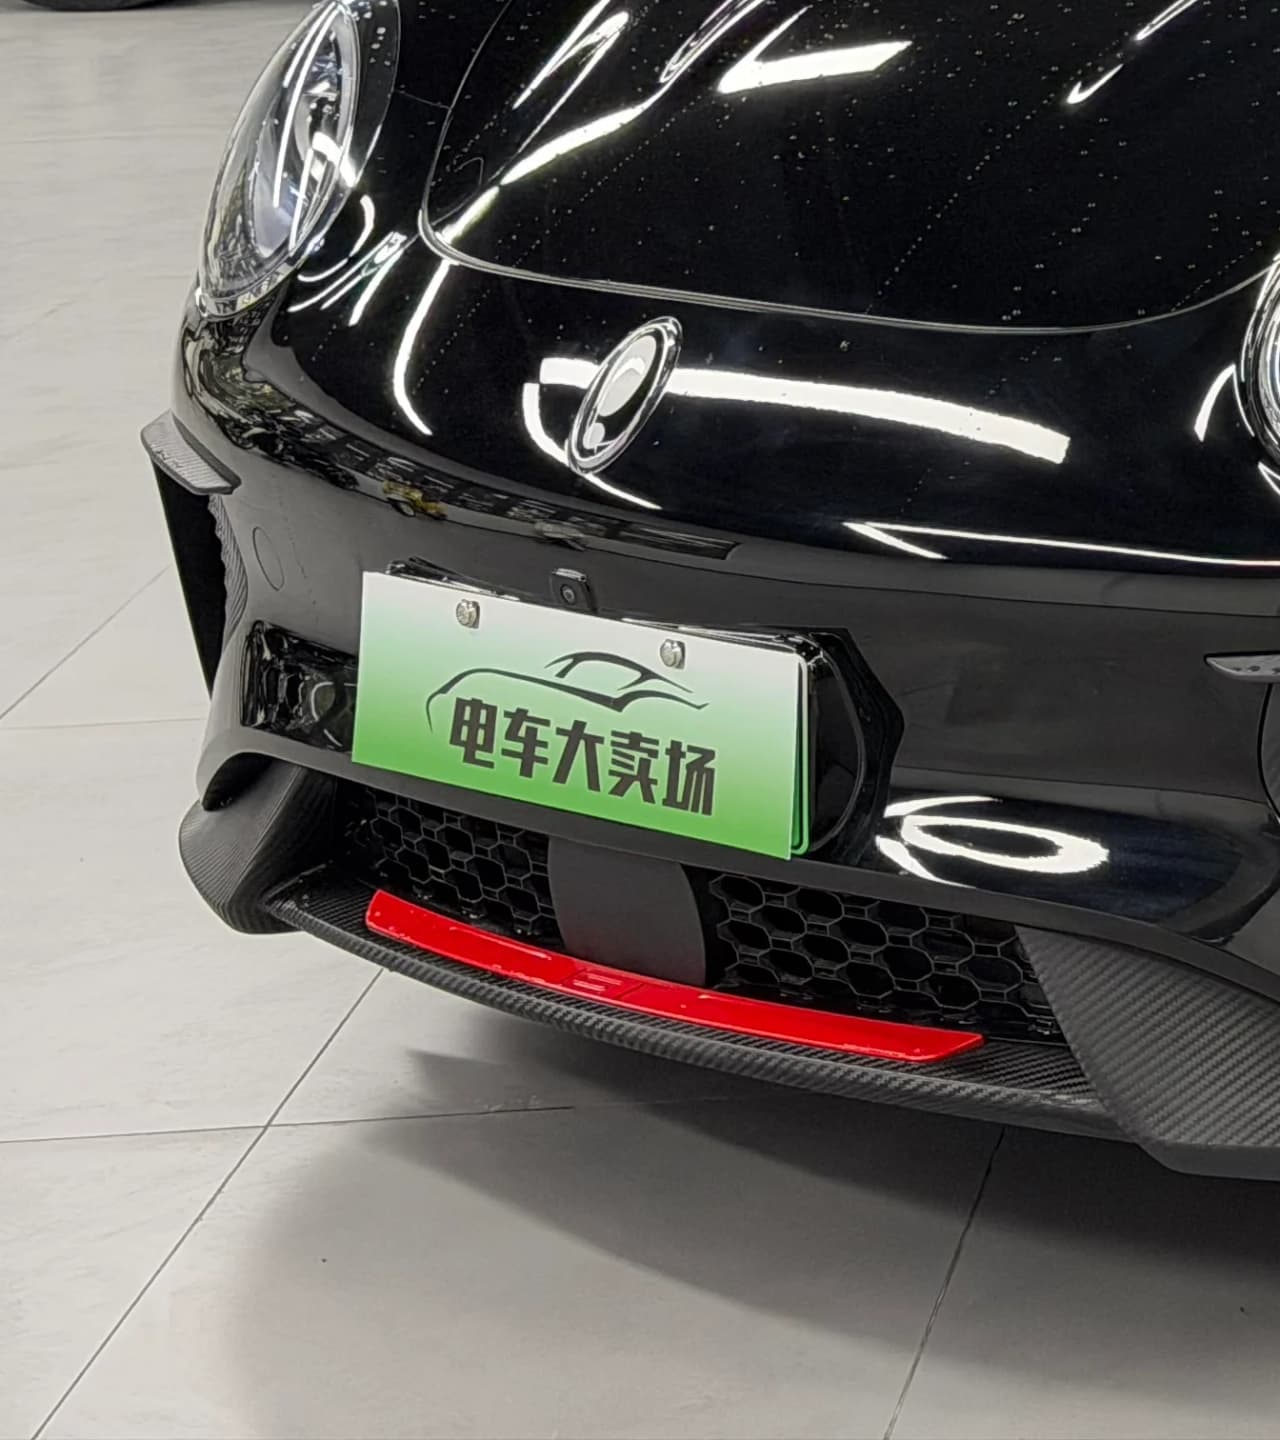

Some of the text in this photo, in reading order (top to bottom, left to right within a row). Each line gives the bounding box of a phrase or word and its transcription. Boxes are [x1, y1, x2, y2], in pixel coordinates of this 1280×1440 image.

[449, 696, 717, 817] 电车大卖场
